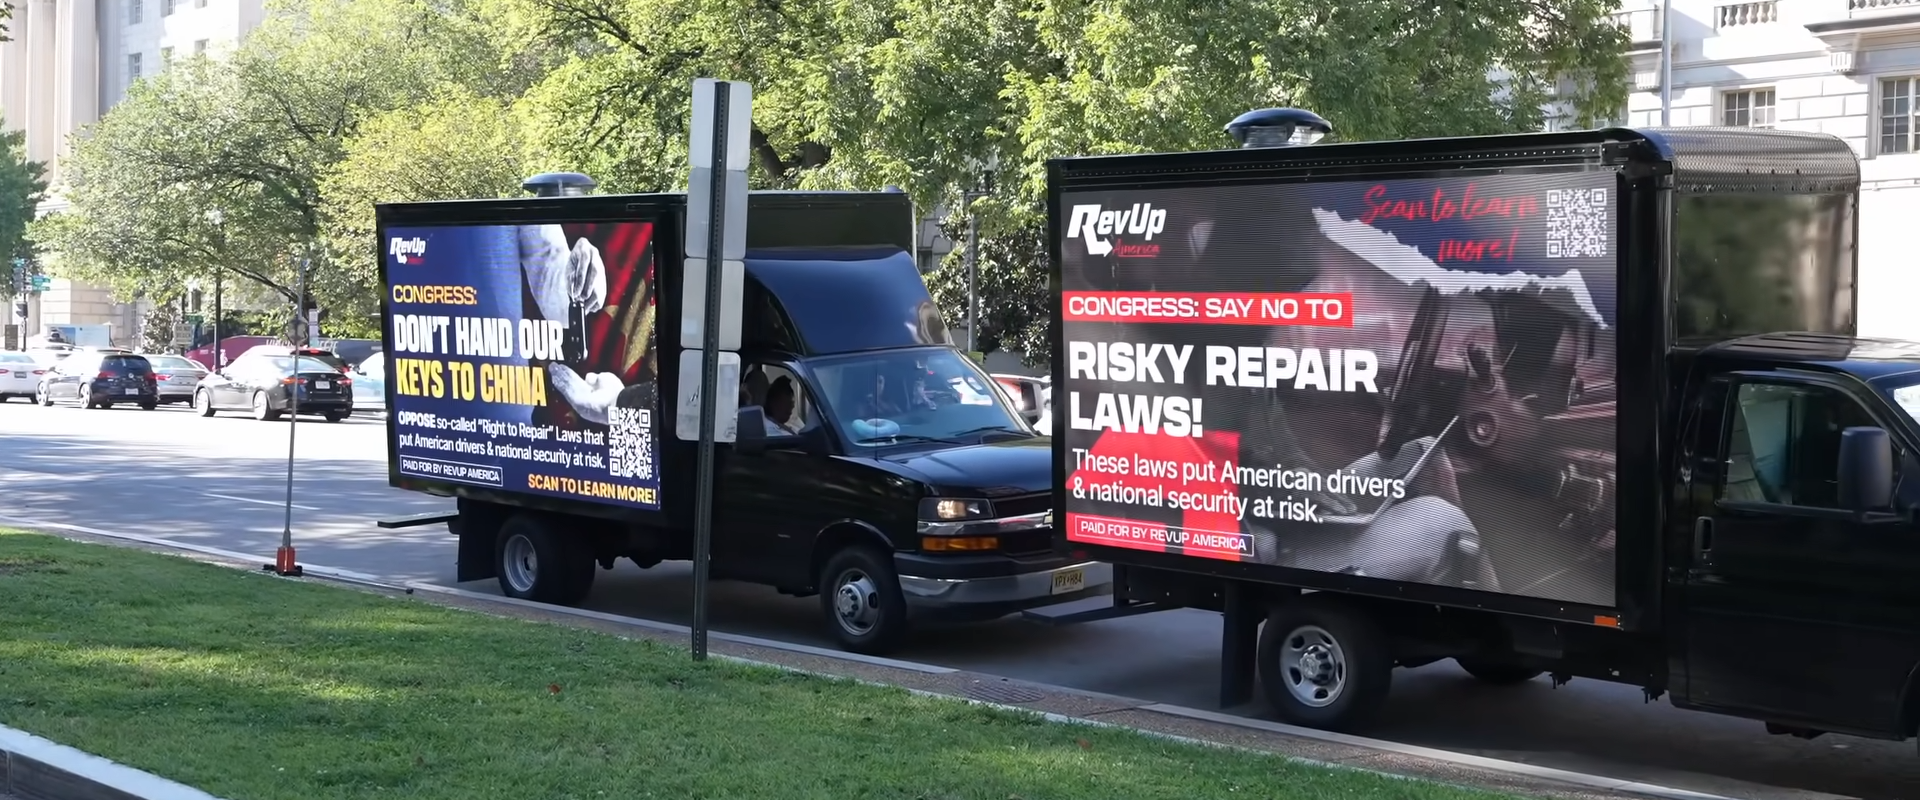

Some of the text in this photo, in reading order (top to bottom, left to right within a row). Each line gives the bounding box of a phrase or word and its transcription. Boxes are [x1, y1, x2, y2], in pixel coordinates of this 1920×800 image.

[1361, 182, 1538, 225] Scan to learn
[1067, 203, 1166, 257] RevUp
[1112, 238, 1160, 257] America
[1437, 226, 1519, 263] more!
[390, 237, 426, 264] RevUp
[393, 285, 477, 305] CONGRESS:
[1068, 296, 1343, 320] CONGRESS: SAY NO TO
[393, 314, 565, 361] DON'T HAND OUR
[395, 357, 547, 407] KEYS TO CHINA
[1069, 341, 1379, 393] RISKY REPAIR
[398, 410, 436, 429] OPPOSE
[436, 417, 477, 432] so-called
[507, 422, 518, 437] to
[555, 426, 582, 444] Laws
[583, 429, 604, 446] that
[1070, 391, 1203, 438] LAWS!
[399, 433, 606, 469] put American drivers & national security at risk.
[403, 459, 500, 481] PAID FOR BY REVUP AMERICA
[1072, 447, 1406, 499] These laws put American drivers
[528, 473, 657, 505] SCAN TO LEARN MORE!
[1072, 476, 1324, 524] & national security at risk.
[1081, 520, 1247, 551] PAID FOR BY REVUP AMERICA
